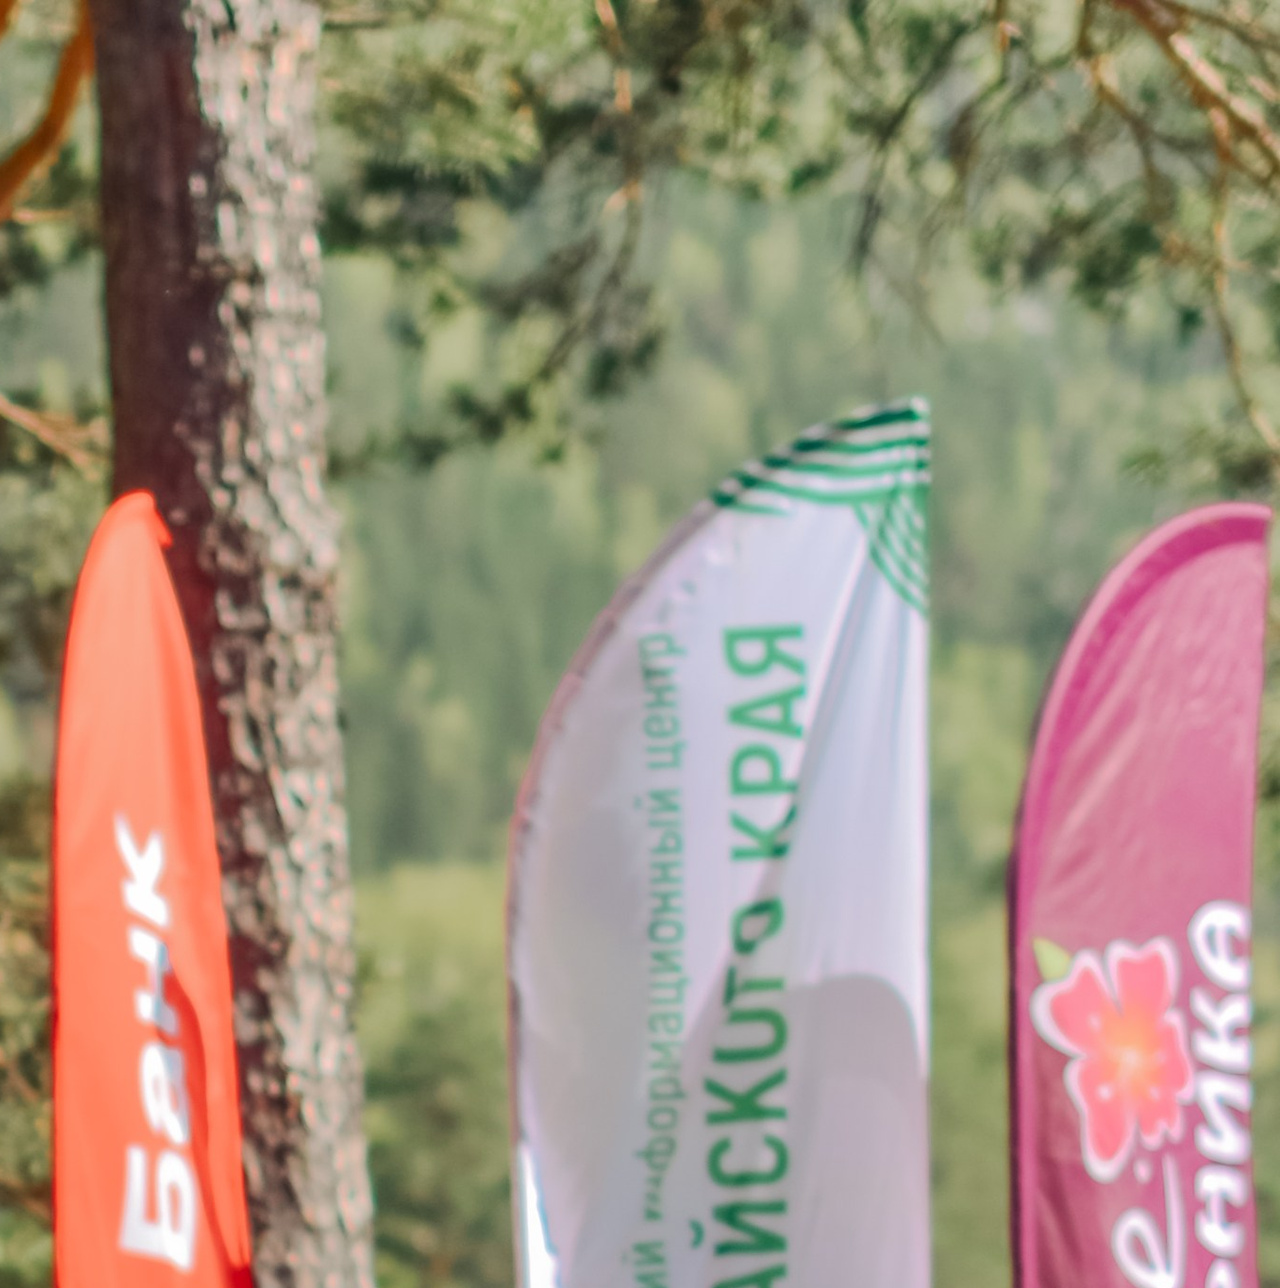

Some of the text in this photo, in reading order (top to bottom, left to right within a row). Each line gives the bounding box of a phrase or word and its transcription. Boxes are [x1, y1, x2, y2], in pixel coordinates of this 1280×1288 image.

[637, 631, 688, 773] центр
[721, 624, 807, 864] КРАЯ
[114, 811, 196, 1274] Банк
